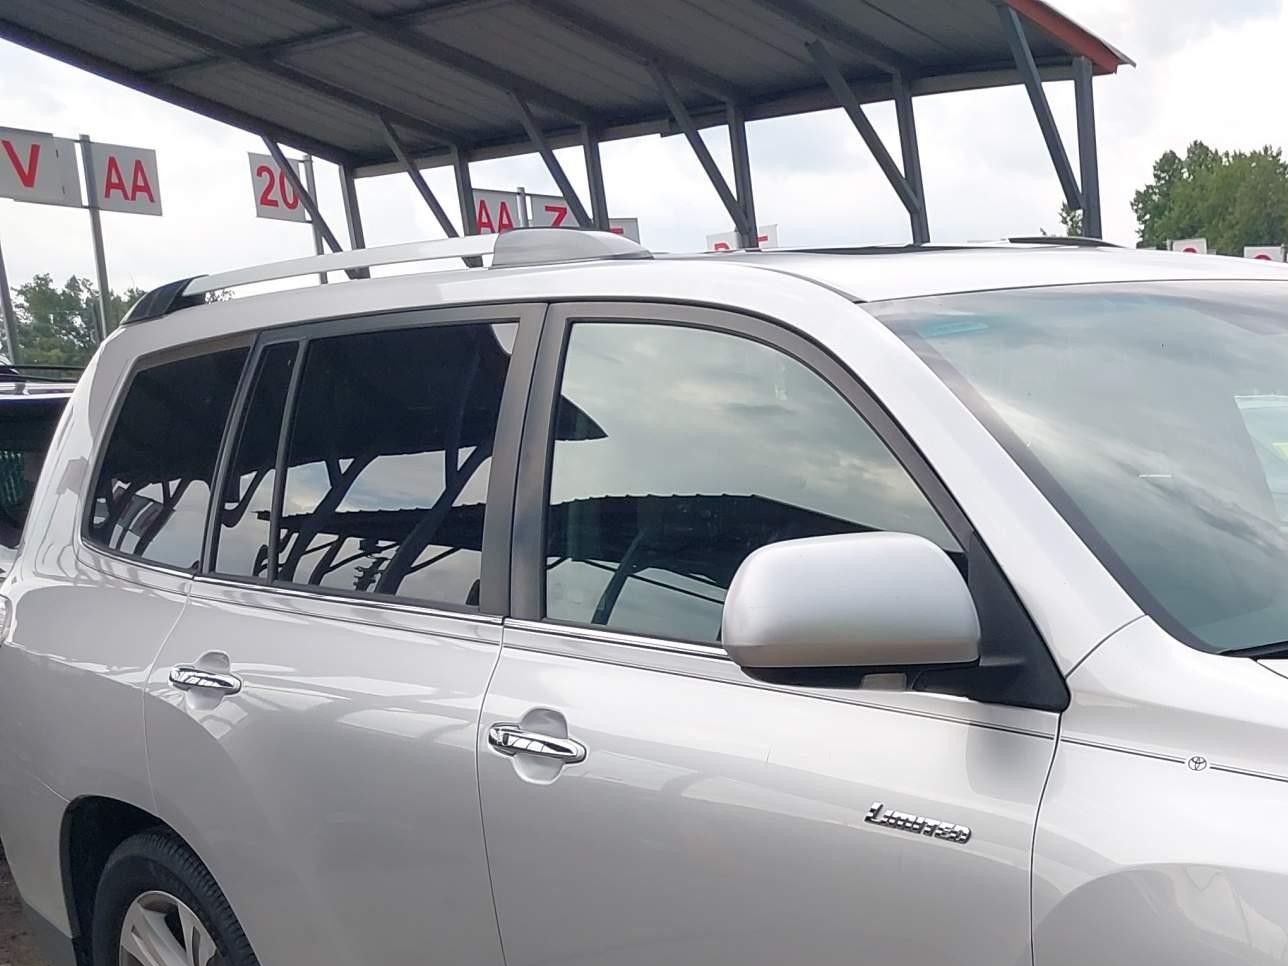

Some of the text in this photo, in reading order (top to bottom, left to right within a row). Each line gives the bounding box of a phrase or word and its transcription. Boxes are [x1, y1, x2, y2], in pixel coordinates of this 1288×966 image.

[1, 140, 40, 188] V
[104, 156, 155, 203] AA
[256, 165, 299, 209] 20
[476, 199, 515, 234] AA
